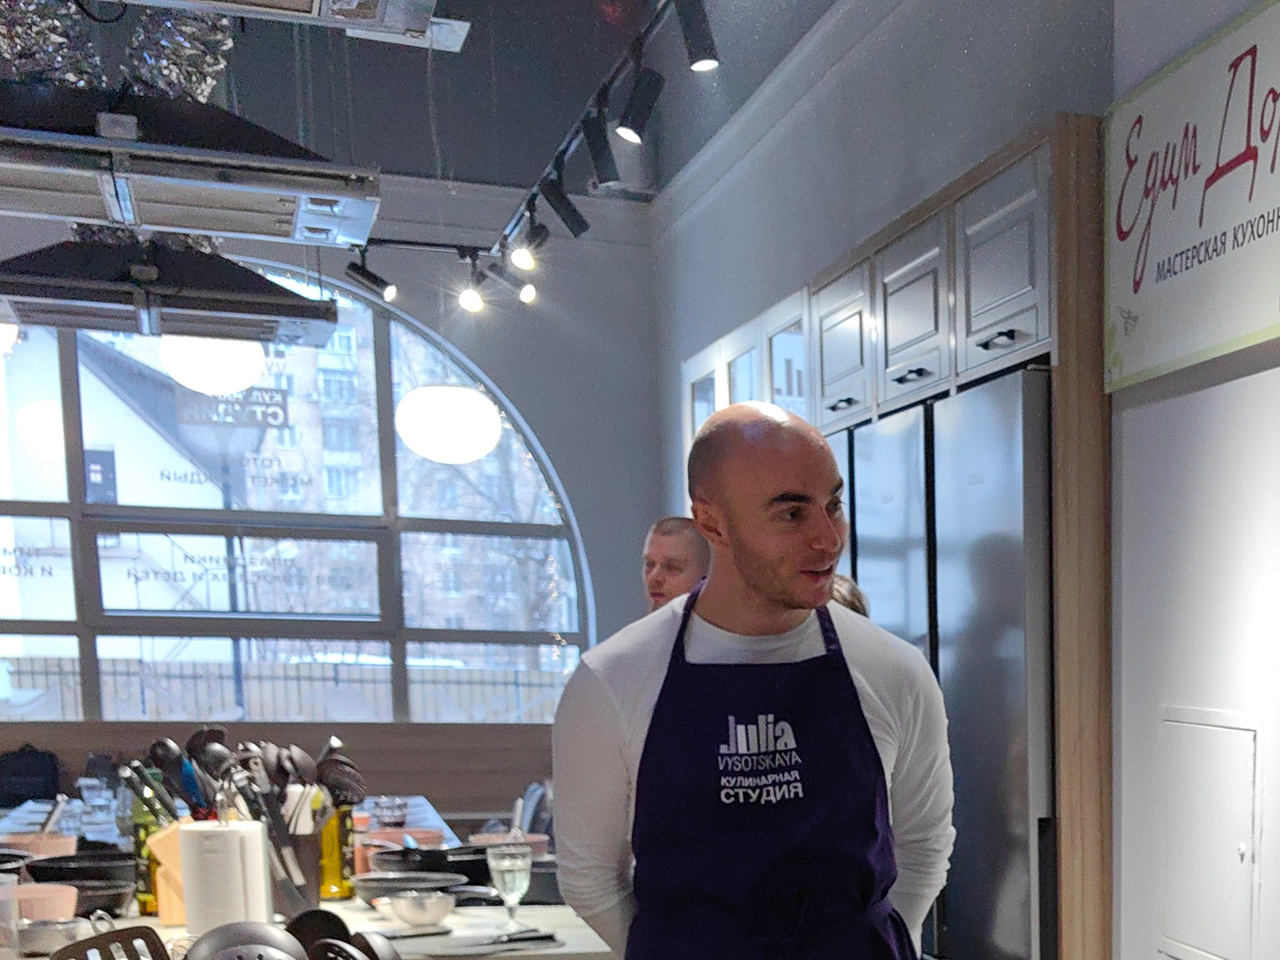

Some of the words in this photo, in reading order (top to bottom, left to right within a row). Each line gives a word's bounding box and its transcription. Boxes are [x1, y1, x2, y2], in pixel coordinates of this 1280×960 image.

[1115, 115, 1200, 294] Едим
[1155, 231, 1227, 284] МАСТЕРСКАЯ
[719, 713, 797, 754] Julia
[717, 750, 802, 771] VYSOTSKAYA
[720, 770, 800, 787] КУЛИНАРНАЯ
[720, 782, 804, 804] СТУДИЯ
